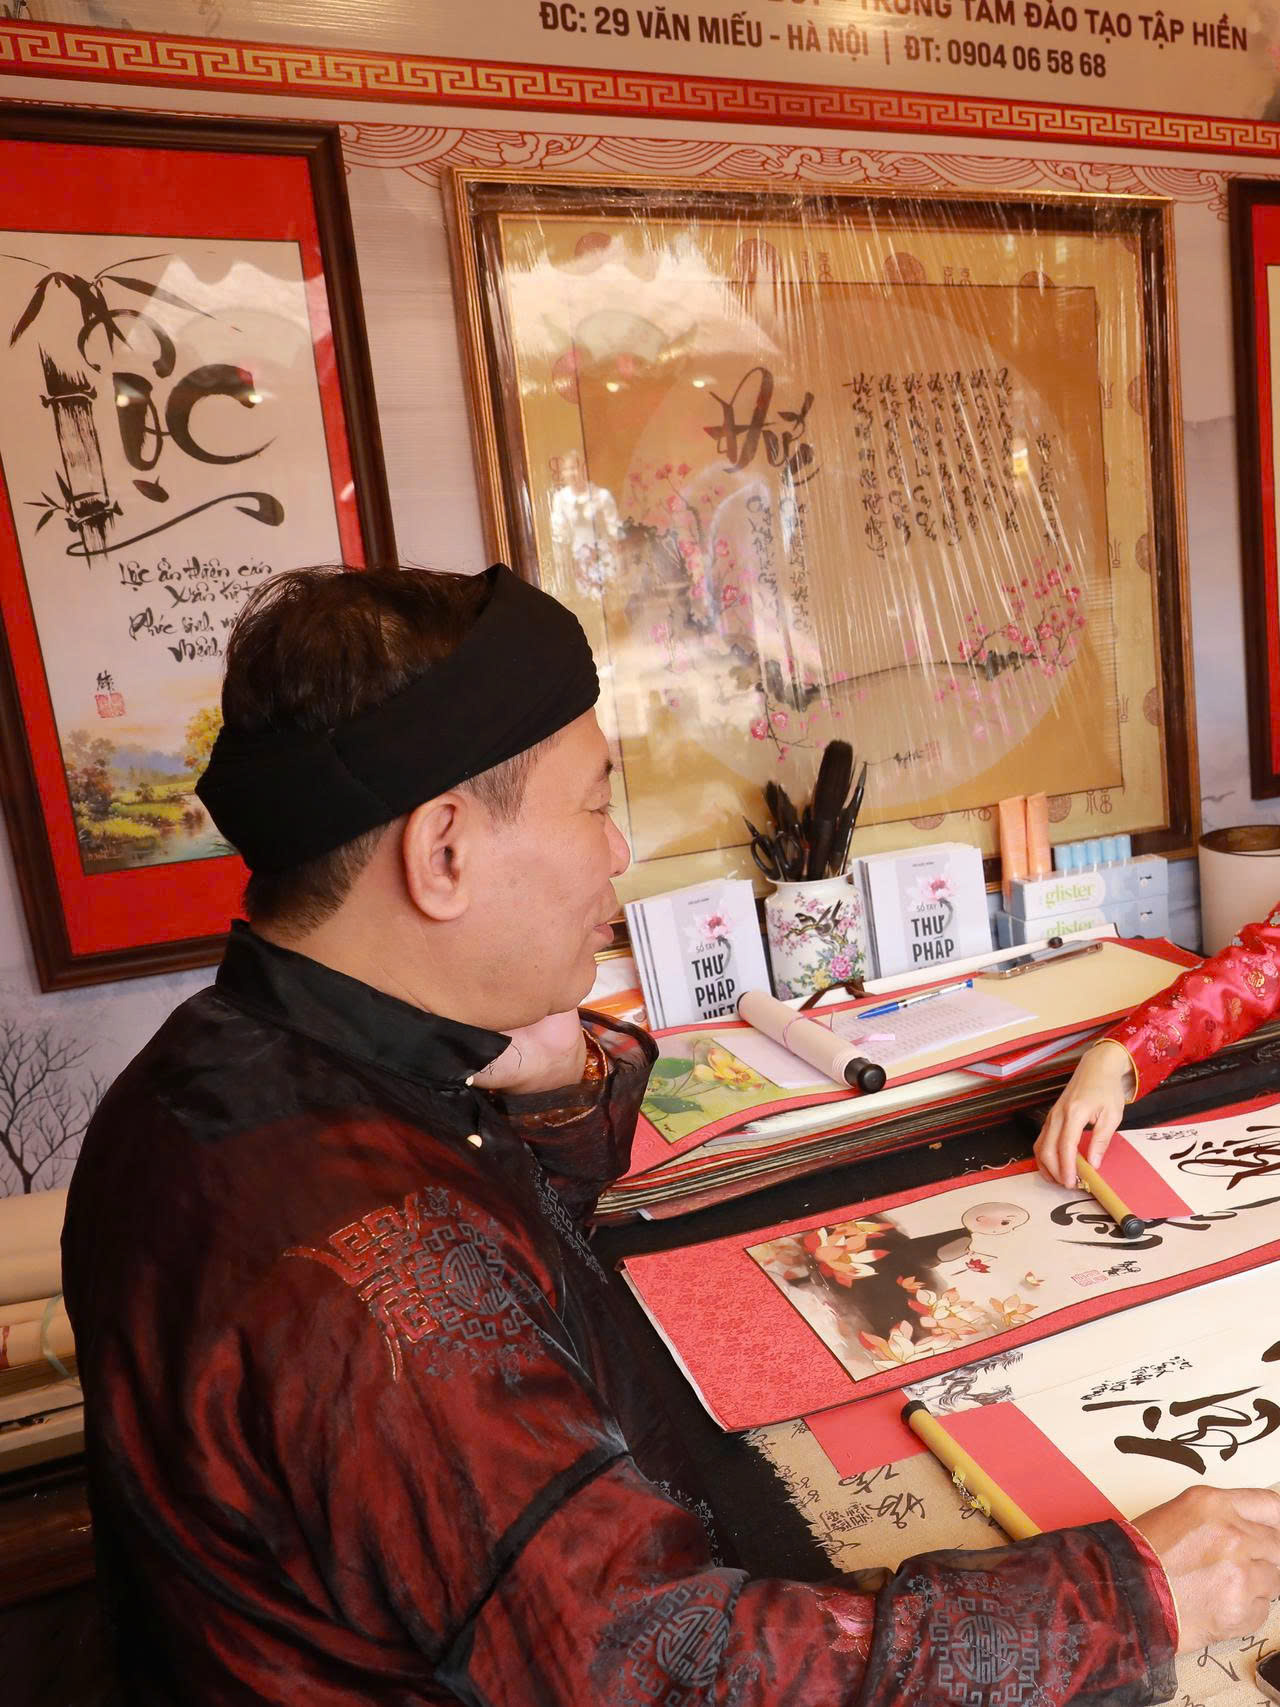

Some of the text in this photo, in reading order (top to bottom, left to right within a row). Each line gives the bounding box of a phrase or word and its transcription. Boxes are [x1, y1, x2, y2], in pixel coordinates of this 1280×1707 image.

[1024, 0, 1077, 32] ĐÀO
[1084, 9, 1132, 43] TẠO
[1138, 10, 1184, 49] TẬP
[539, 1, 587, 32] ĐC:
[594, 6, 630, 36] 29
[637, 7, 691, 42] VĂN
[698, 11, 763, 47] MIẾU
[788, 20, 821, 52] HÀ
[828, 24, 868, 61] NỘI
[904, 35, 941, 62] ĐT:
[947, 39, 1007, 68] 0904
[1013, 45, 1041, 72] 06
[1047, 49, 1074, 75] 58
[1080, 53, 1106, 78] 68
[1045, 883, 1095, 909] glister
[911, 914, 945, 938] THƯ
[912, 935, 954, 962] PHÁP
[691, 953, 724, 980] THƯ
[695, 975, 735, 1007] PHÁP
